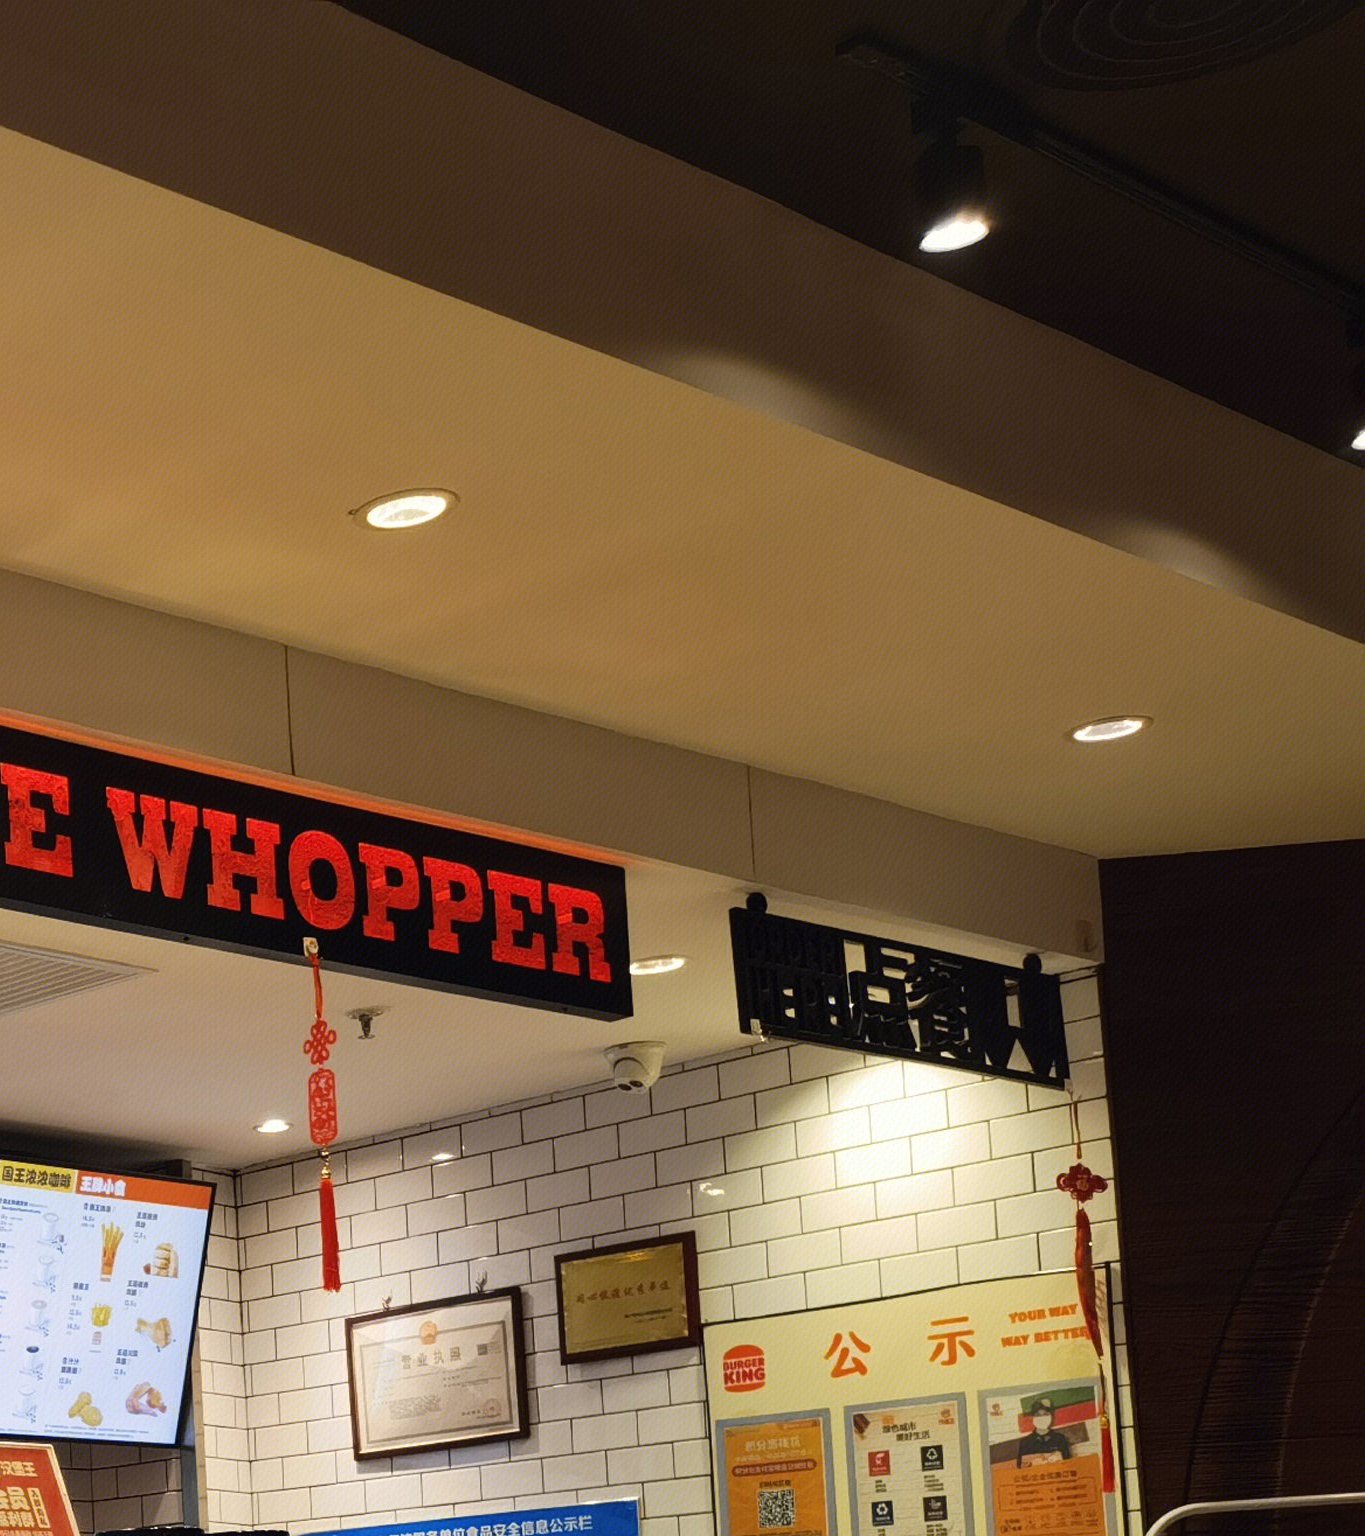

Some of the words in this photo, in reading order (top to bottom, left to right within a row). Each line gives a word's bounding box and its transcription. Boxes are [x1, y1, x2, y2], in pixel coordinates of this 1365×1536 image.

[105, 785, 612, 984] WHOPPER
[1007, 1307, 1046, 1324] YOUR
[1047, 1303, 1079, 1319] WAY
[1001, 1333, 1031, 1348] WAY
[722, 1355, 766, 1372] BURGER
[722, 1367, 766, 1386] KING
[0, 1460, 38, 1477] 汉堡王
